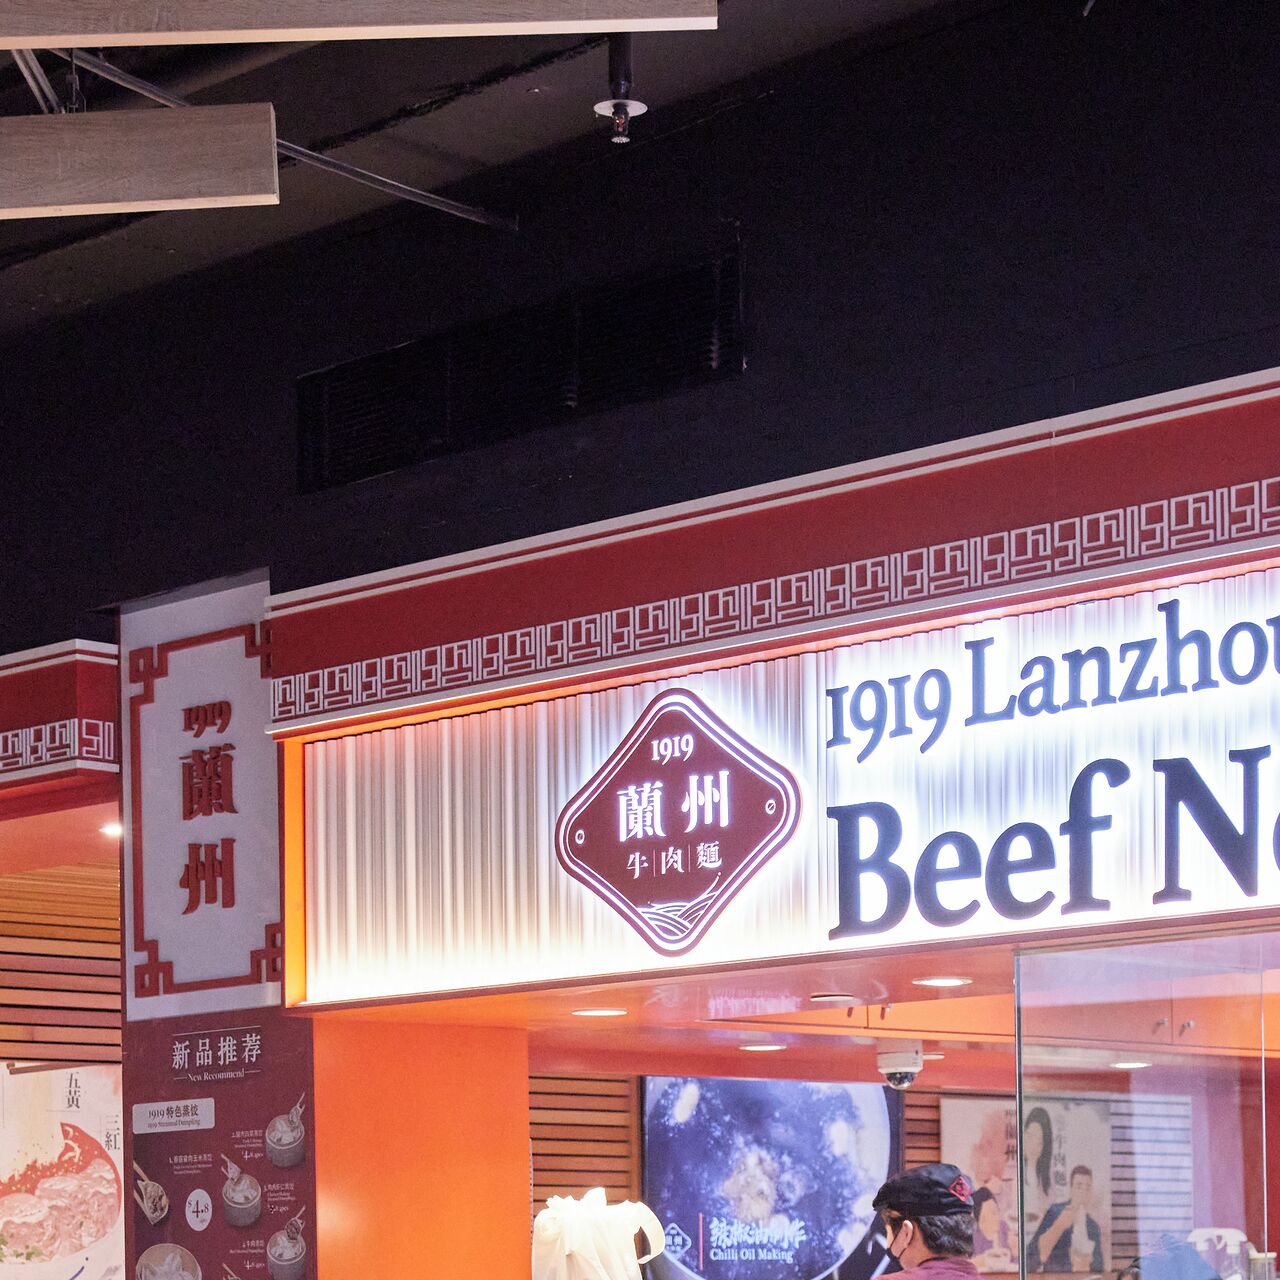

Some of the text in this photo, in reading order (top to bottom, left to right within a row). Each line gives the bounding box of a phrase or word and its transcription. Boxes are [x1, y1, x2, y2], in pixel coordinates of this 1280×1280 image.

[182, 701, 232, 738] 1919
[827, 672, 953, 764] 1919
[651, 735, 694, 765] 1919
[617, 770, 730, 842] 蘭州
[179, 743, 238, 915] 蘭州
[828, 759, 1126, 940] Beef
[172, 1033, 261, 1069] 新品推荐
[188, 1068, 244, 1082] New Recommend
[148, 1109, 165, 1119] 1919
[710, 1248, 794, 1264] Chilli Oil Making
